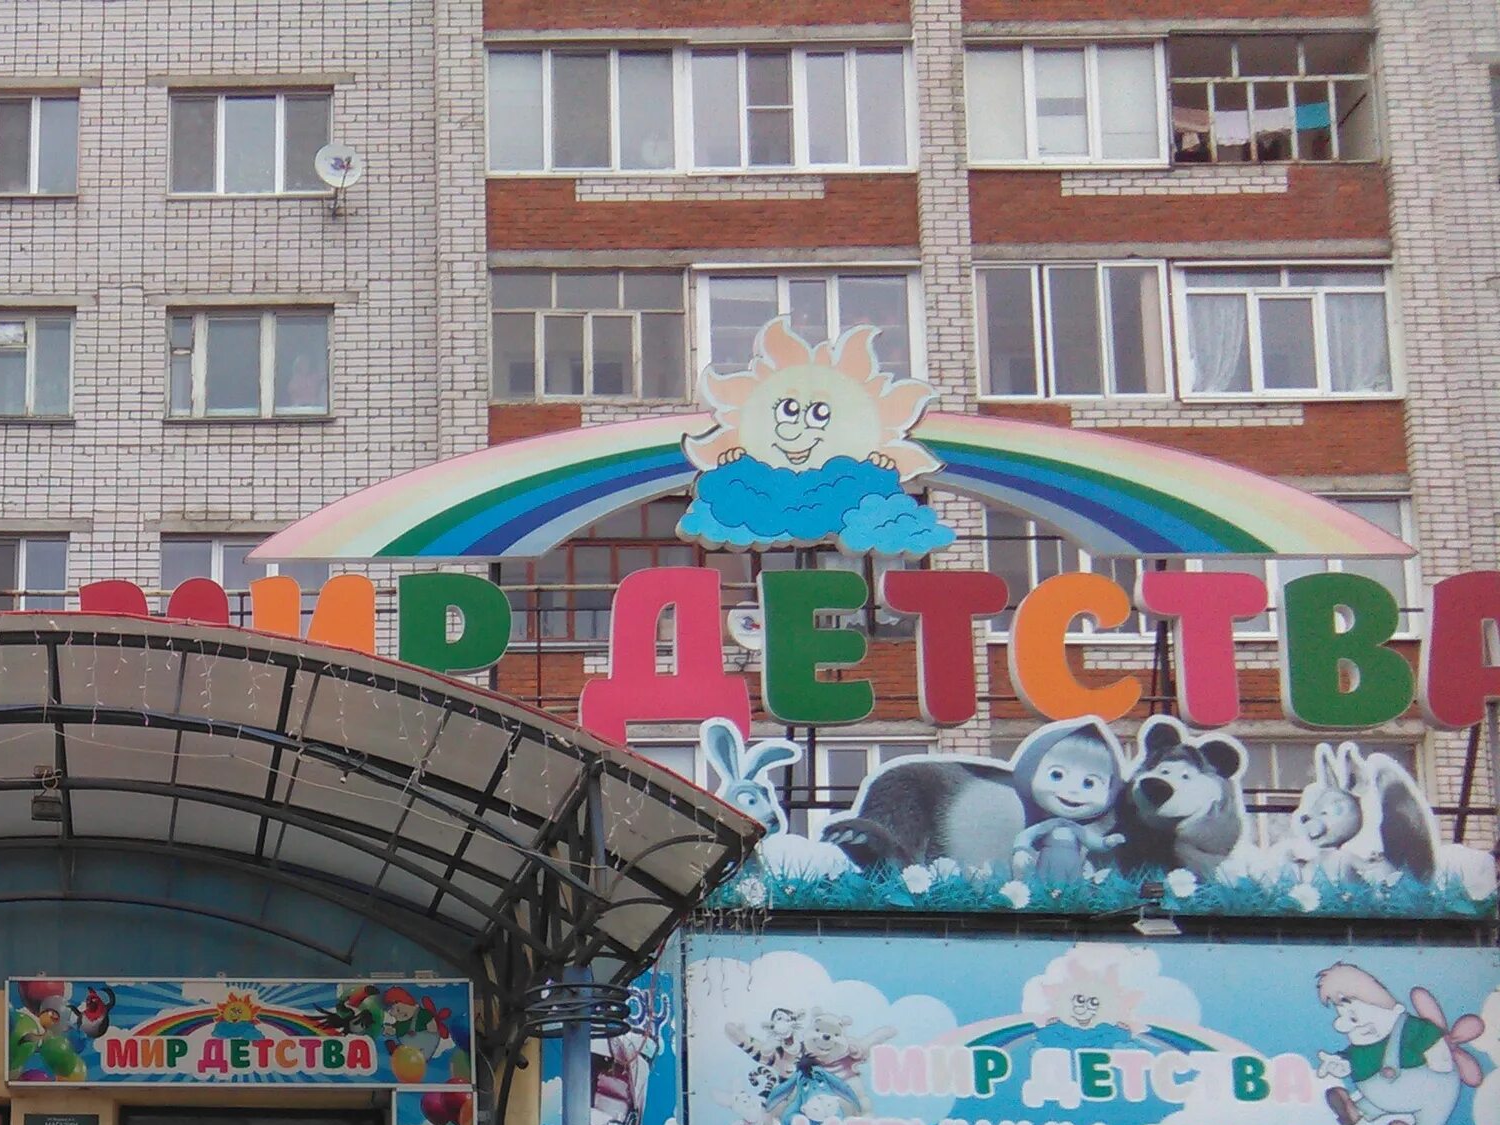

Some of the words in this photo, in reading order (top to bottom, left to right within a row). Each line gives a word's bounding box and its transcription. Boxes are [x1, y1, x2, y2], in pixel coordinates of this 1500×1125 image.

[106, 1038, 188, 1069] МИР
[197, 1038, 372, 1074] ДЕТСТВА
[872, 1045, 1010, 1096] МИР
